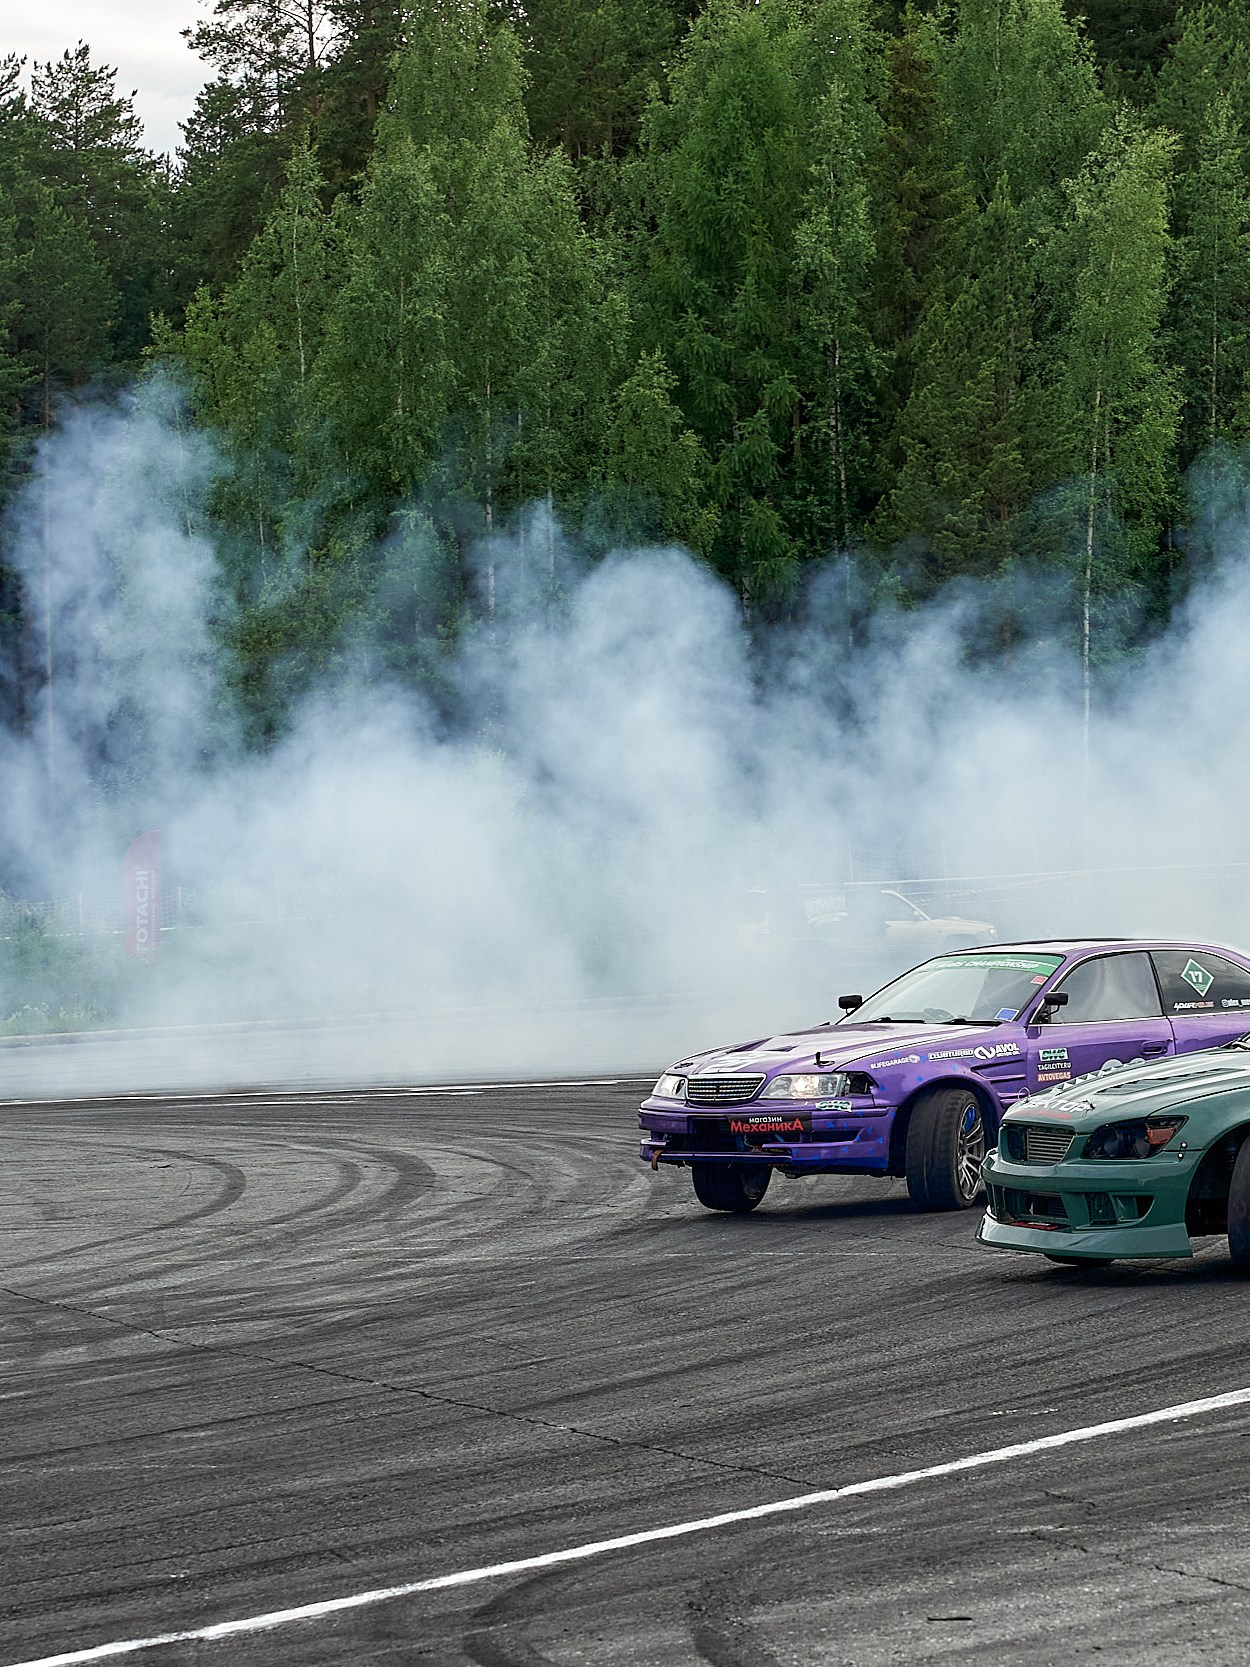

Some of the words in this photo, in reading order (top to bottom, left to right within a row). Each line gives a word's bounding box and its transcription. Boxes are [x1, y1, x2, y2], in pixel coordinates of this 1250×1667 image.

[136, 870, 149, 953] TOTACHI
[1188, 971, 1203, 983] 17
[995, 1042, 1020, 1054] AVOL
[929, 1048, 974, 1061] CLUBTURBO
[1042, 1049, 1066, 1060] DWC
[1037, 1062, 1071, 1071] TAGILCITY.RU
[1038, 1072, 1071, 1082] AVTOVEGAS
[749, 1116, 783, 1124] магазин
